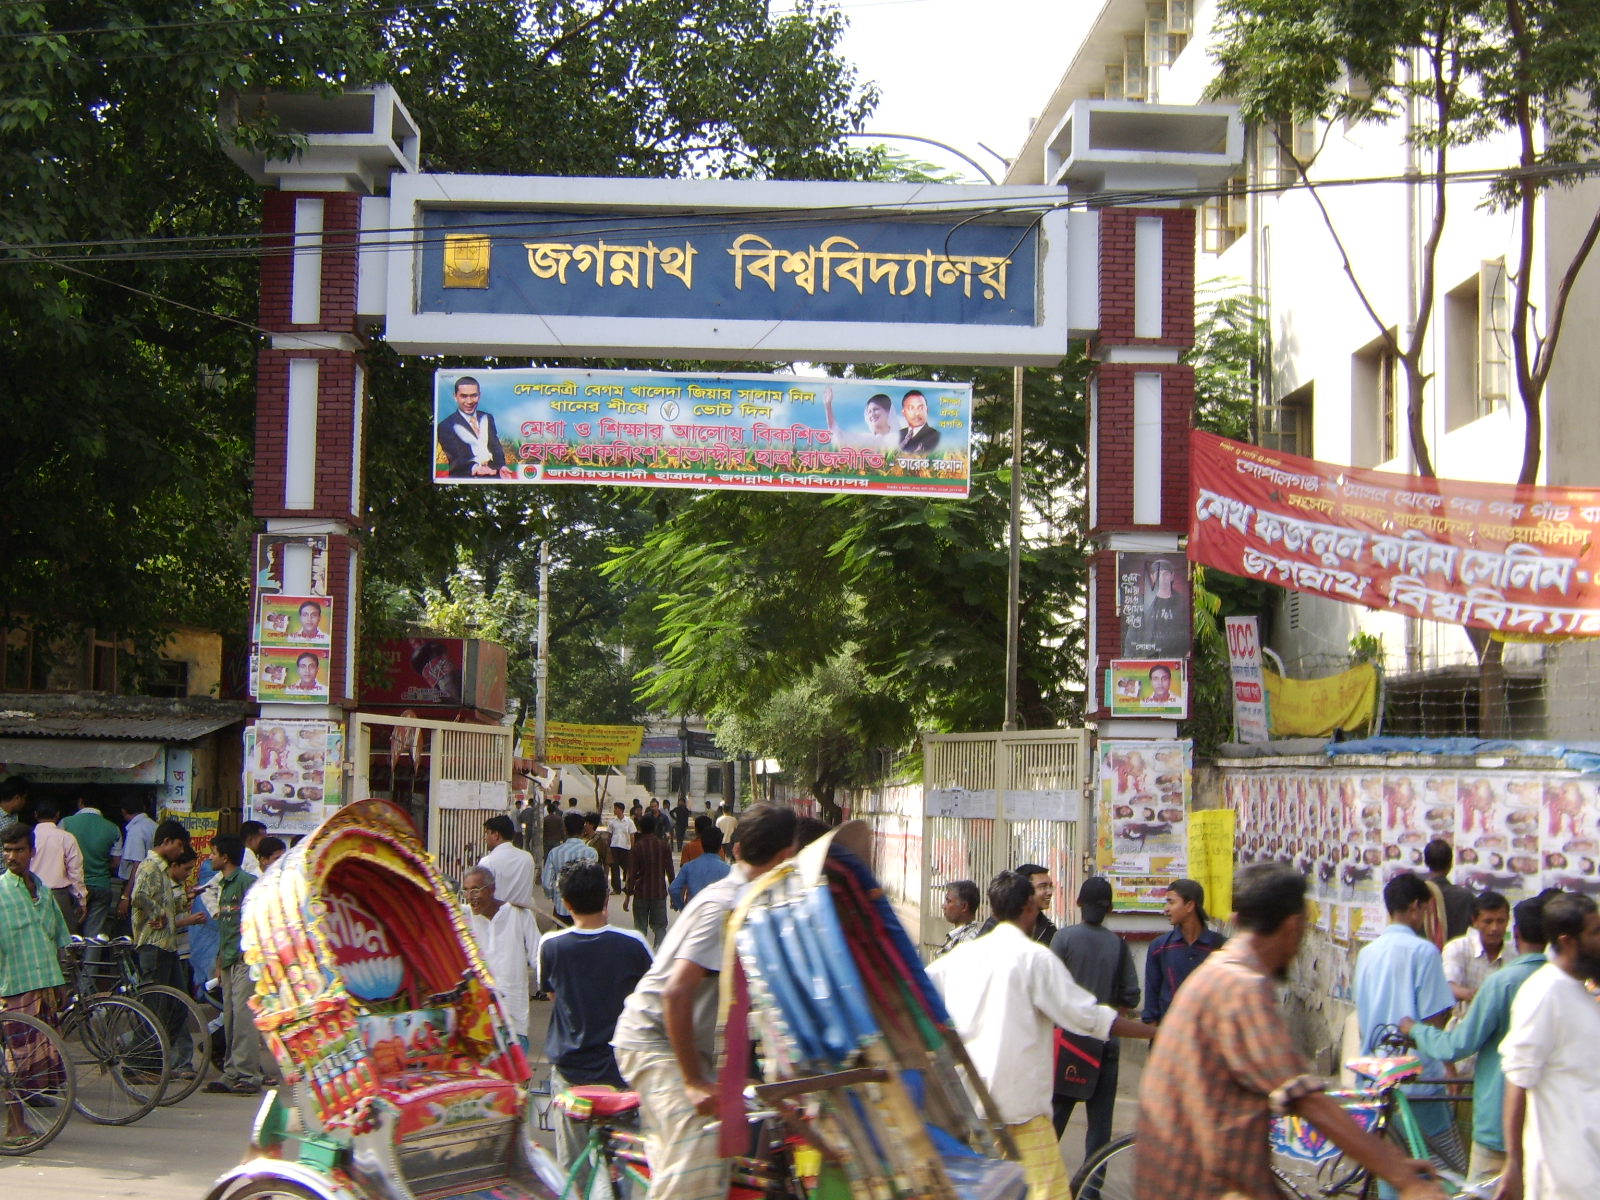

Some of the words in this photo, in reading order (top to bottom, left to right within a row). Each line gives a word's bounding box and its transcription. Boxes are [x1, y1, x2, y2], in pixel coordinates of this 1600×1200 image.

[522, 240, 698, 290] জগন্নাথ
[726, 233, 1012, 300] বিশ্ববিদ্যালয়
[513, 381, 579, 396] দেশনেত্রী
[584, 385, 624, 398] বেগম
[630, 386, 682, 399] খালেদা
[687, 384, 732, 400] জিয়ার
[738, 388, 783, 403] সালাম
[788, 387, 816, 404] নিন
[550, 400, 599, 413] ধানের
[607, 398, 648, 414] শীষে
[692, 403, 734, 417] ভোট
[740, 403, 773, 420] দিন
[520, 420, 566, 438] মেধা
[574, 422, 591, 437] ও
[598, 417, 664, 441] শিক্ষার
[671, 423, 745, 443] আলোয়
[751, 422, 833, 446] বিকশিত
[519, 442, 568, 461] হোক
[576, 441, 659, 463] একবিংশ
[667, 442, 746, 466] শতাব্দীর
[753, 449, 793, 468] ছাত্র
[798, 447, 885, 470] রাজনীতি
[897, 458, 930, 471] তারেক
[932, 459, 964, 473] রহমান
[546, 466, 649, 480] জাতীয়তাবাদী
[719, 472, 773, 484] জগন্নাথ
[779, 473, 870, 488] বিশ্ববিদ্যালয়
[1450, 496, 1482, 516] পর
[1488, 501, 1525, 520] পর
[1531, 500, 1573, 522] পাঁচ
[1196, 488, 1256, 536] শেখ
[1254, 508, 1370, 568] ফজলুল
[1371, 529, 1459, 584] করিম
[1460, 542, 1578, 596] সেলিম
[1243, 547, 1372, 599] জগন্নাথ
[1227, 623, 1256, 658] UCC
